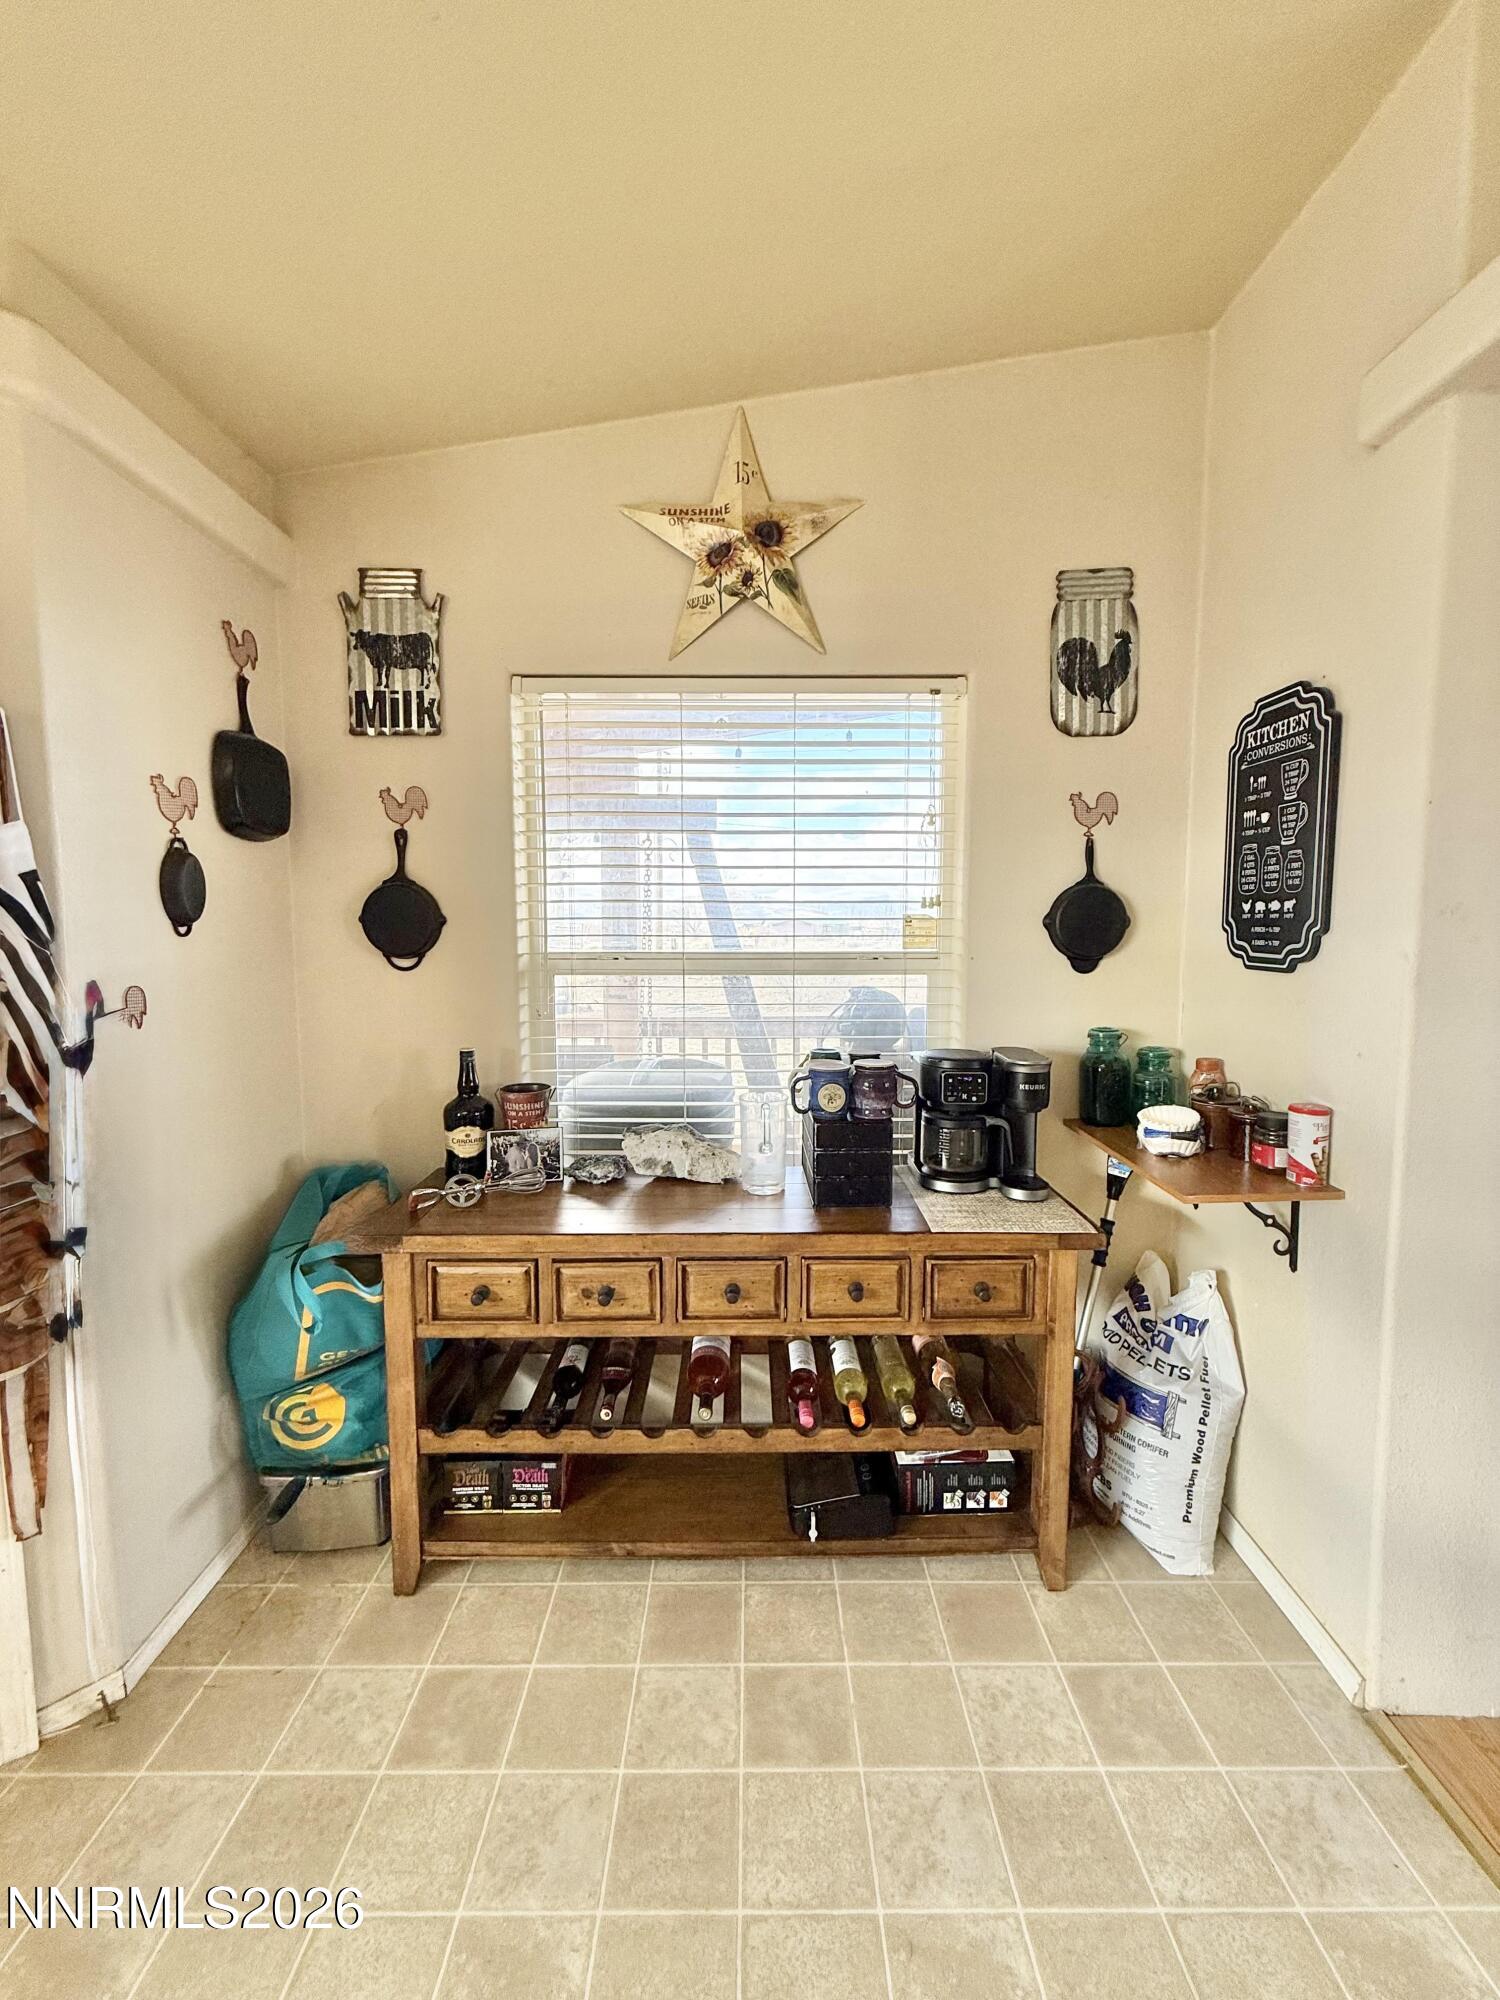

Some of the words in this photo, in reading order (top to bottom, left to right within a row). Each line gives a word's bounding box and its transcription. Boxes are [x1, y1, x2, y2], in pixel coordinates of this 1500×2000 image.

[659, 502, 731, 517] SUNSHINE
[668, 517, 684, 527] ON
[354, 690, 438, 729] Milk
[1246, 710, 1311, 749] KITCHEN
[504, 1101, 545, 1111] SUNSHINE
[1199, 1356, 1210, 1385] Fuel
[1198, 1387, 1212, 1427] Pellet
[1191, 1429, 1207, 1465] Wood
[453, 1469, 490, 1487] Death
[512, 1468, 549, 1484] Death
[1182, 1469, 1199, 1524] Premium
